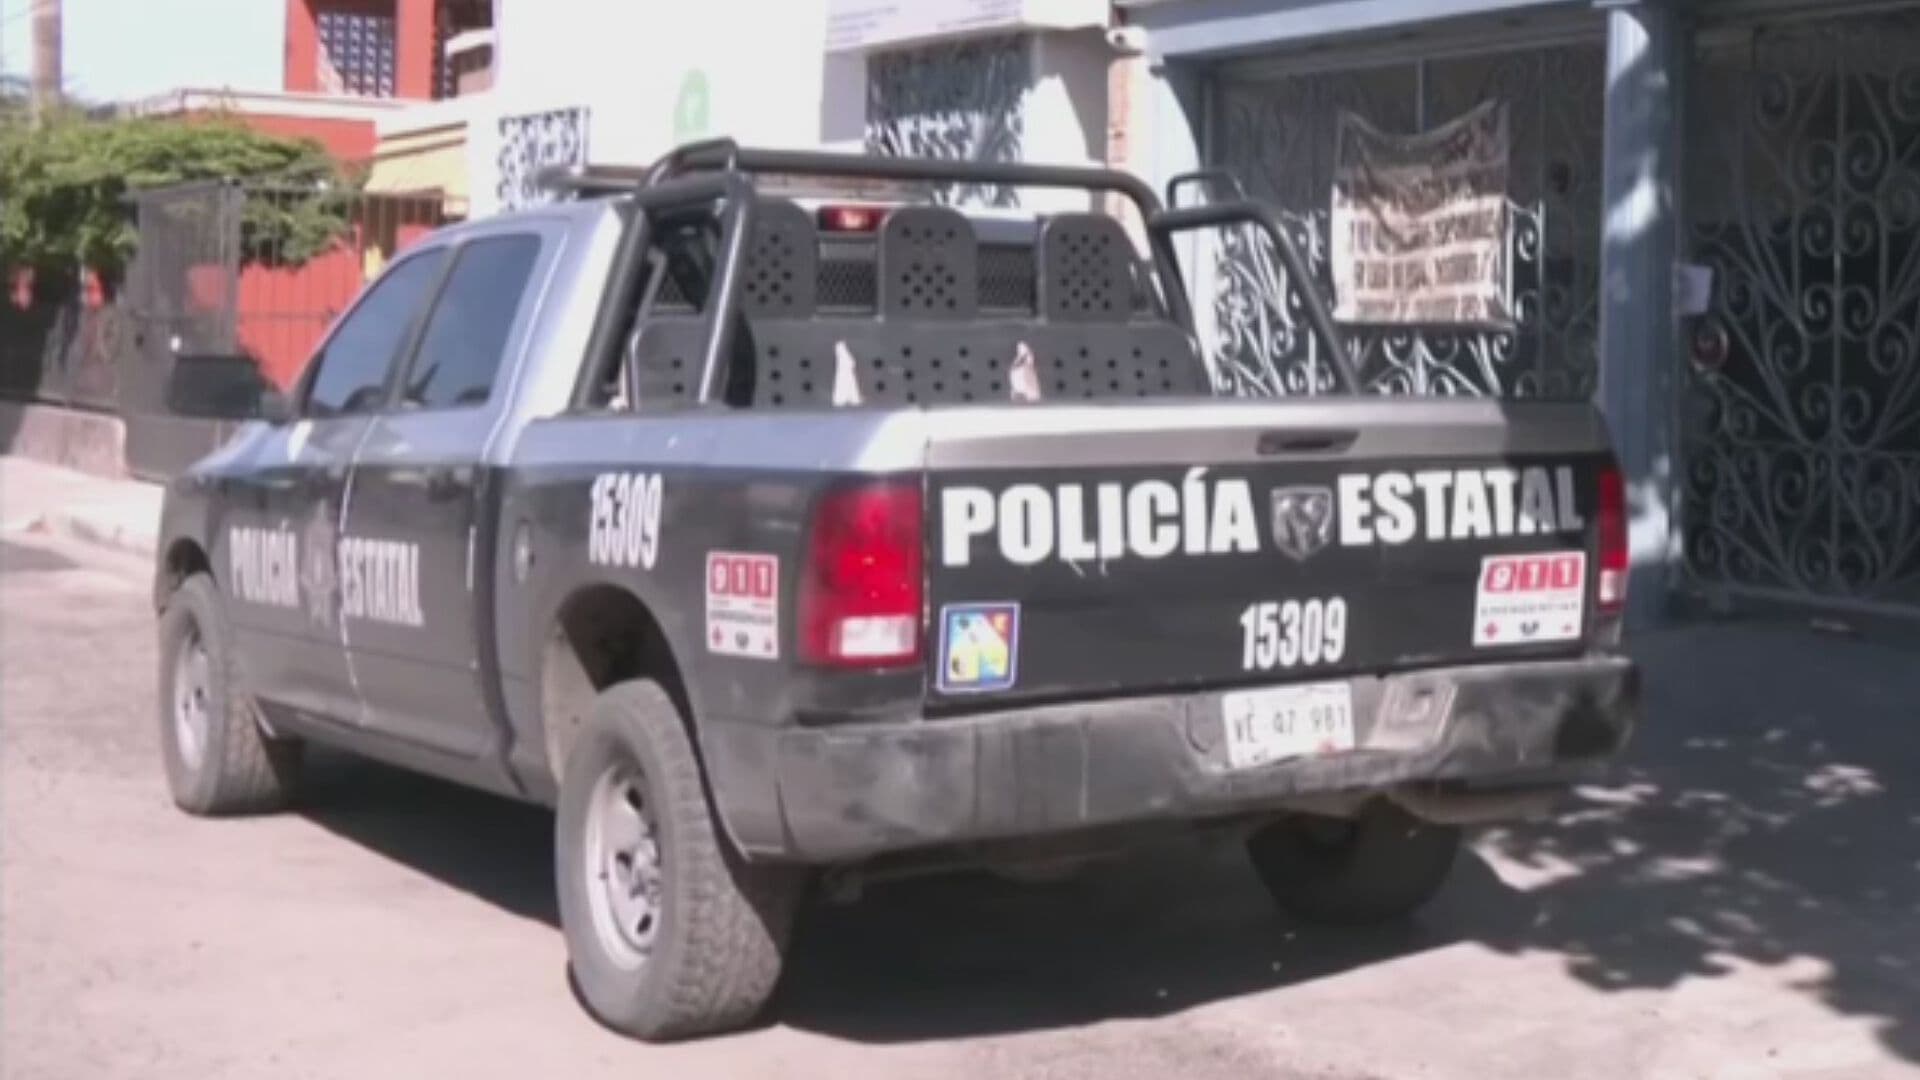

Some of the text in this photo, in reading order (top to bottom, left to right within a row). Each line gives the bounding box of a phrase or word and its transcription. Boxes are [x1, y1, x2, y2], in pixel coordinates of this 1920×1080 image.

[588, 473, 662, 570] 15309
[942, 466, 1584, 566] POLICÍA ESTATAL
[229, 519, 425, 628] POLICÍA ESTATAL
[711, 560, 772, 596] 911
[1487, 558, 1576, 591] 911
[1240, 597, 1347, 671] 15309
